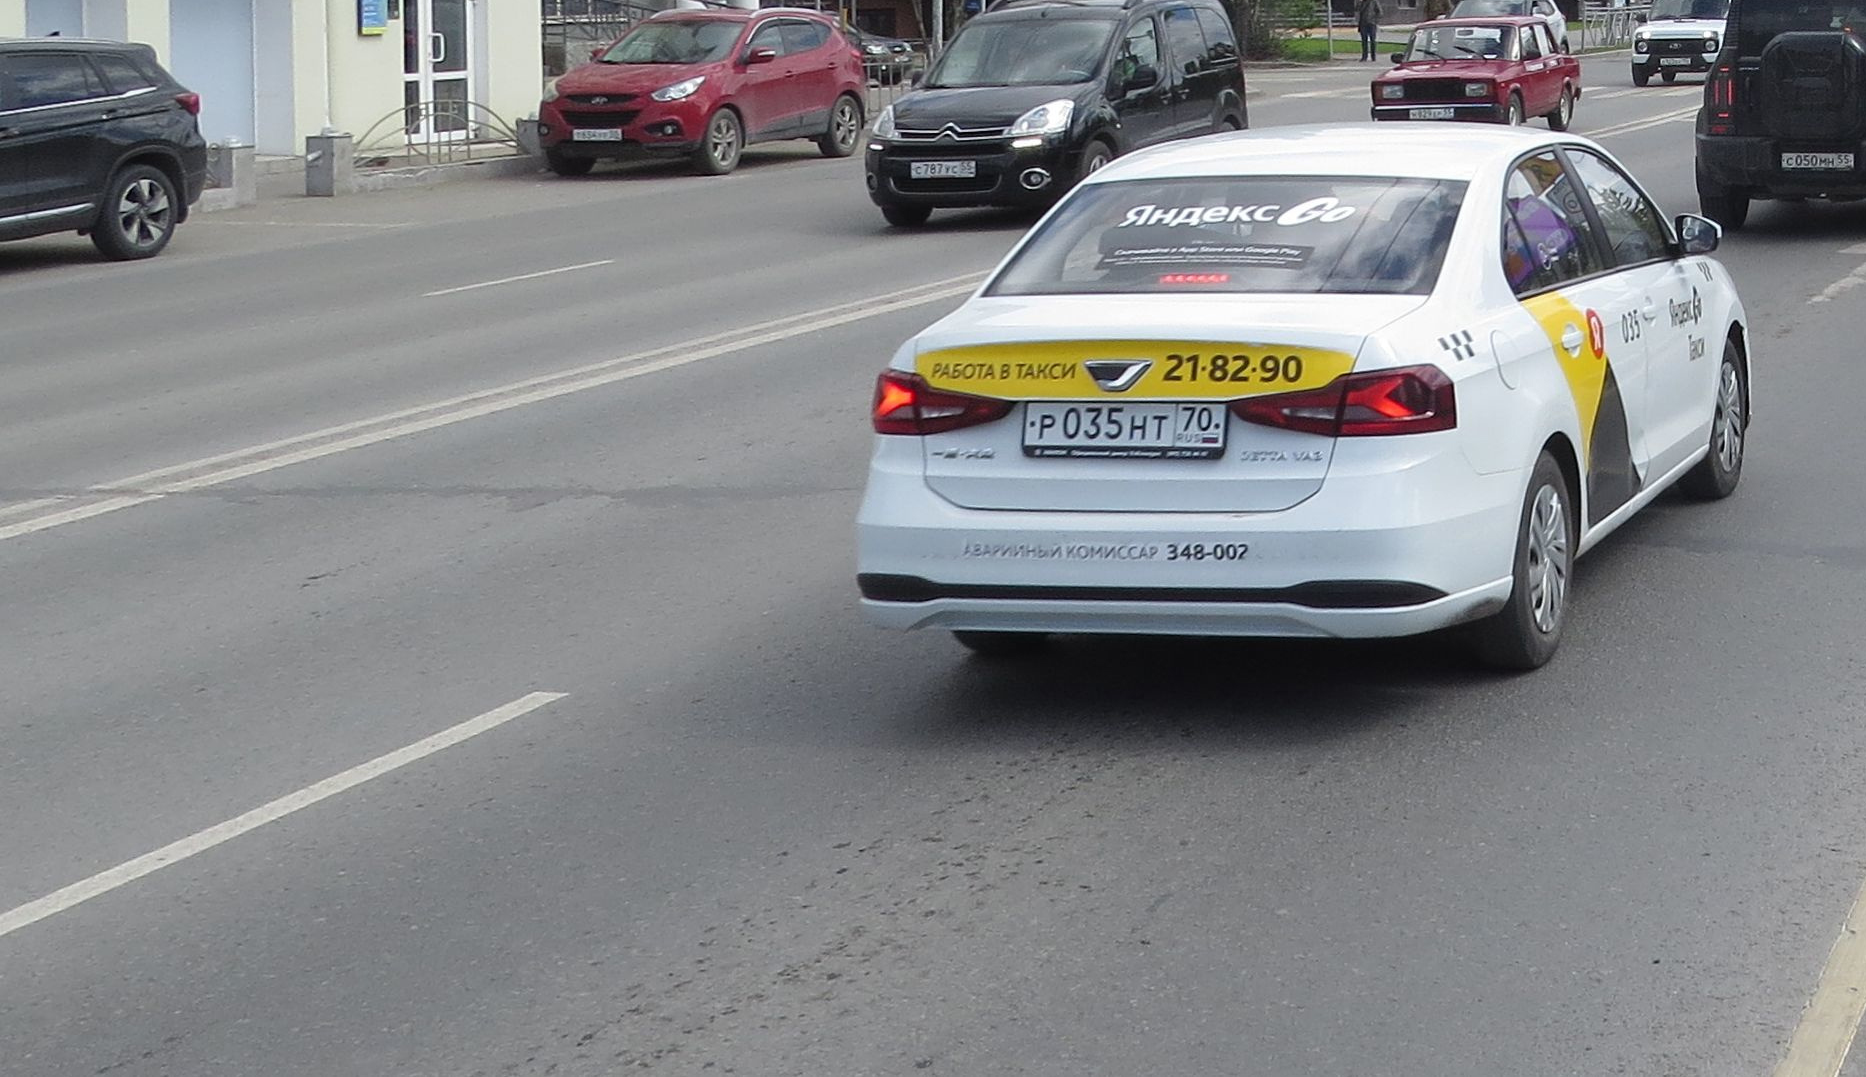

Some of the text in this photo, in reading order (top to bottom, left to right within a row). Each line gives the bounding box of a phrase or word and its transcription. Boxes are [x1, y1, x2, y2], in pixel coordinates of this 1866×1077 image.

[1118, 196, 1356, 228] Яндекс Go
[1621, 309, 1641, 343] 035
[931, 362, 1077, 380] РАБОТА В ТАКСИ
[1066, 544, 1159, 560] КОМИССАР
[1166, 542, 1249, 561] 348-002
